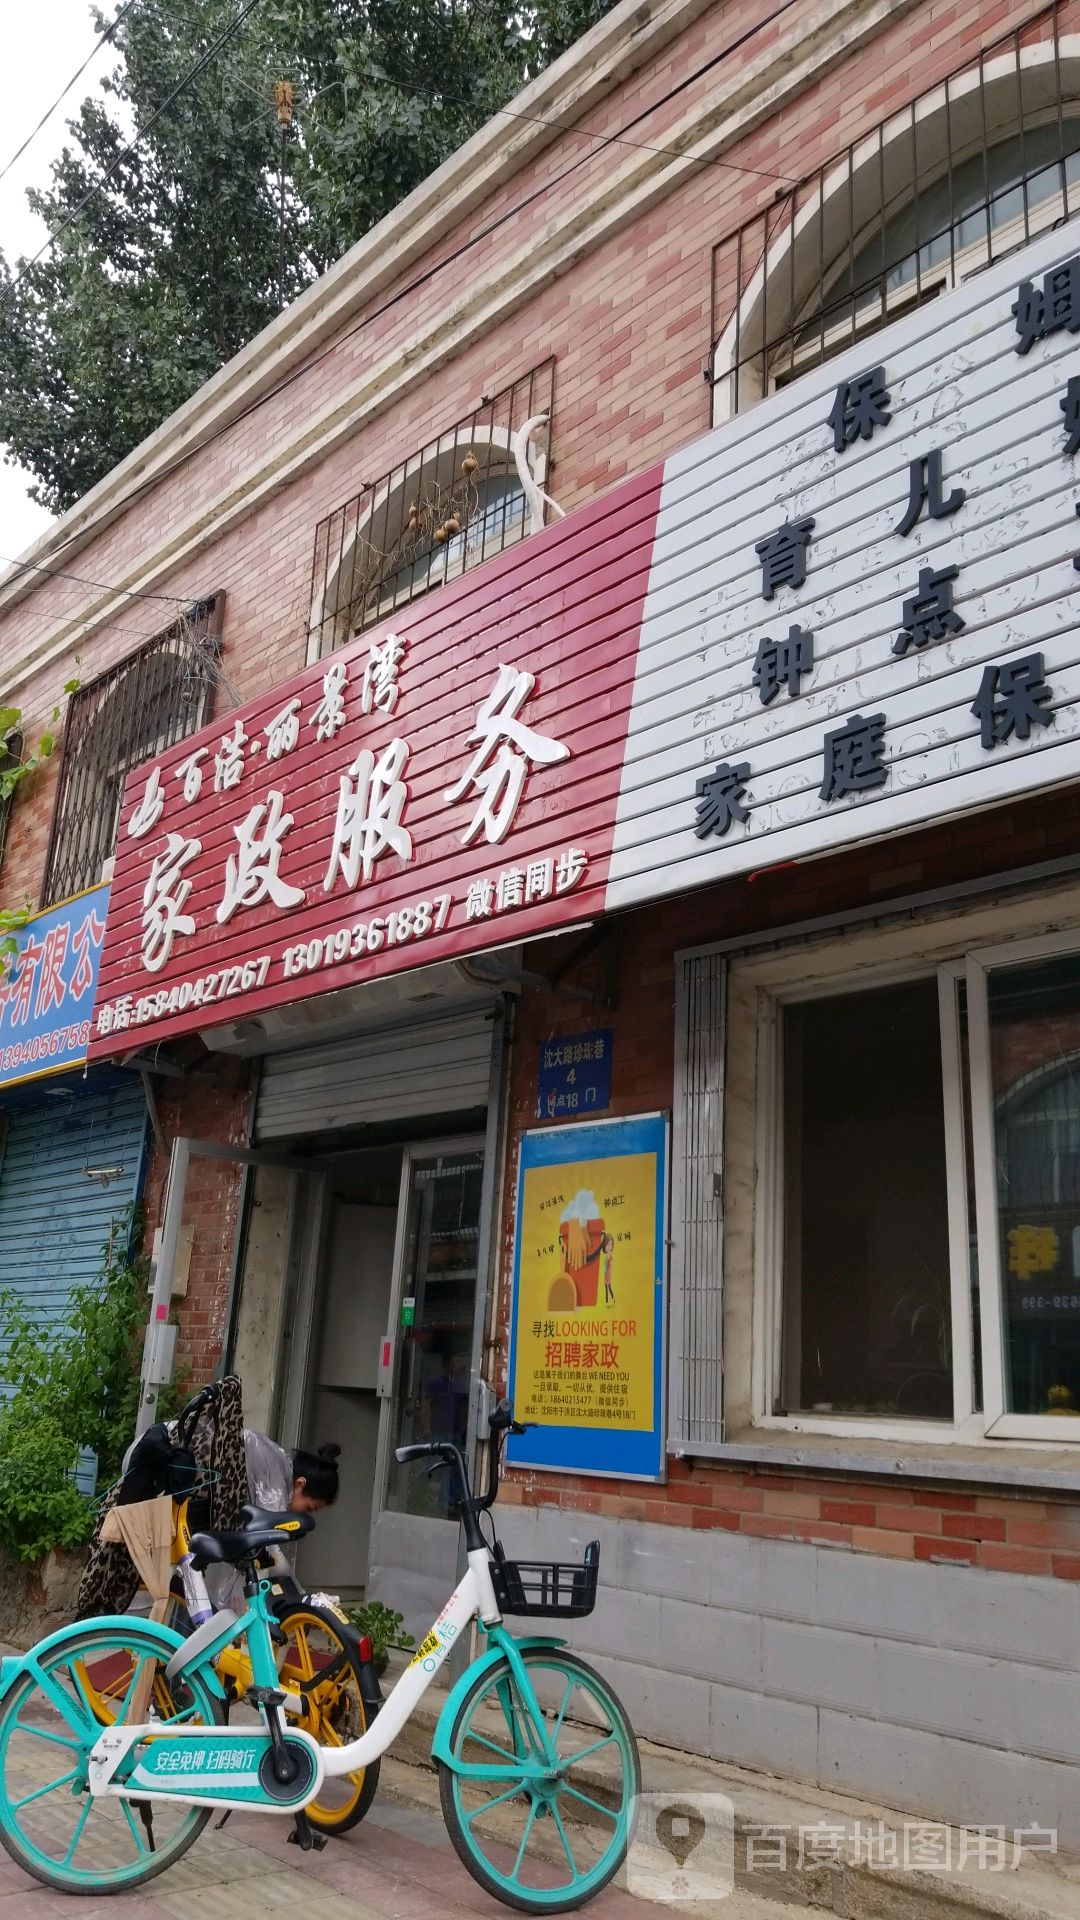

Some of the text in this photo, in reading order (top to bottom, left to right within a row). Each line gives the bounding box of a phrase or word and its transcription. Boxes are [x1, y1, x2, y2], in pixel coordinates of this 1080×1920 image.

[141, 662, 572, 974] 家政服务
[281, 893, 455, 981] 13019361887
[464, 847, 592, 921] 微信同步
[543, 1038, 605, 1069] 沈大路珍珠巷
[566, 1068, 577, 1085] 4
[585, 1087, 597, 1103] 门
[611, 1320, 637, 1337] FOR
[544, 1340, 620, 1369] 招聘家政
[533, 1370, 630, 1381] 这是属于我们的舞台 WE NEED YOU
[154, 1749, 257, 1771] 安全免押 扫码骑行
